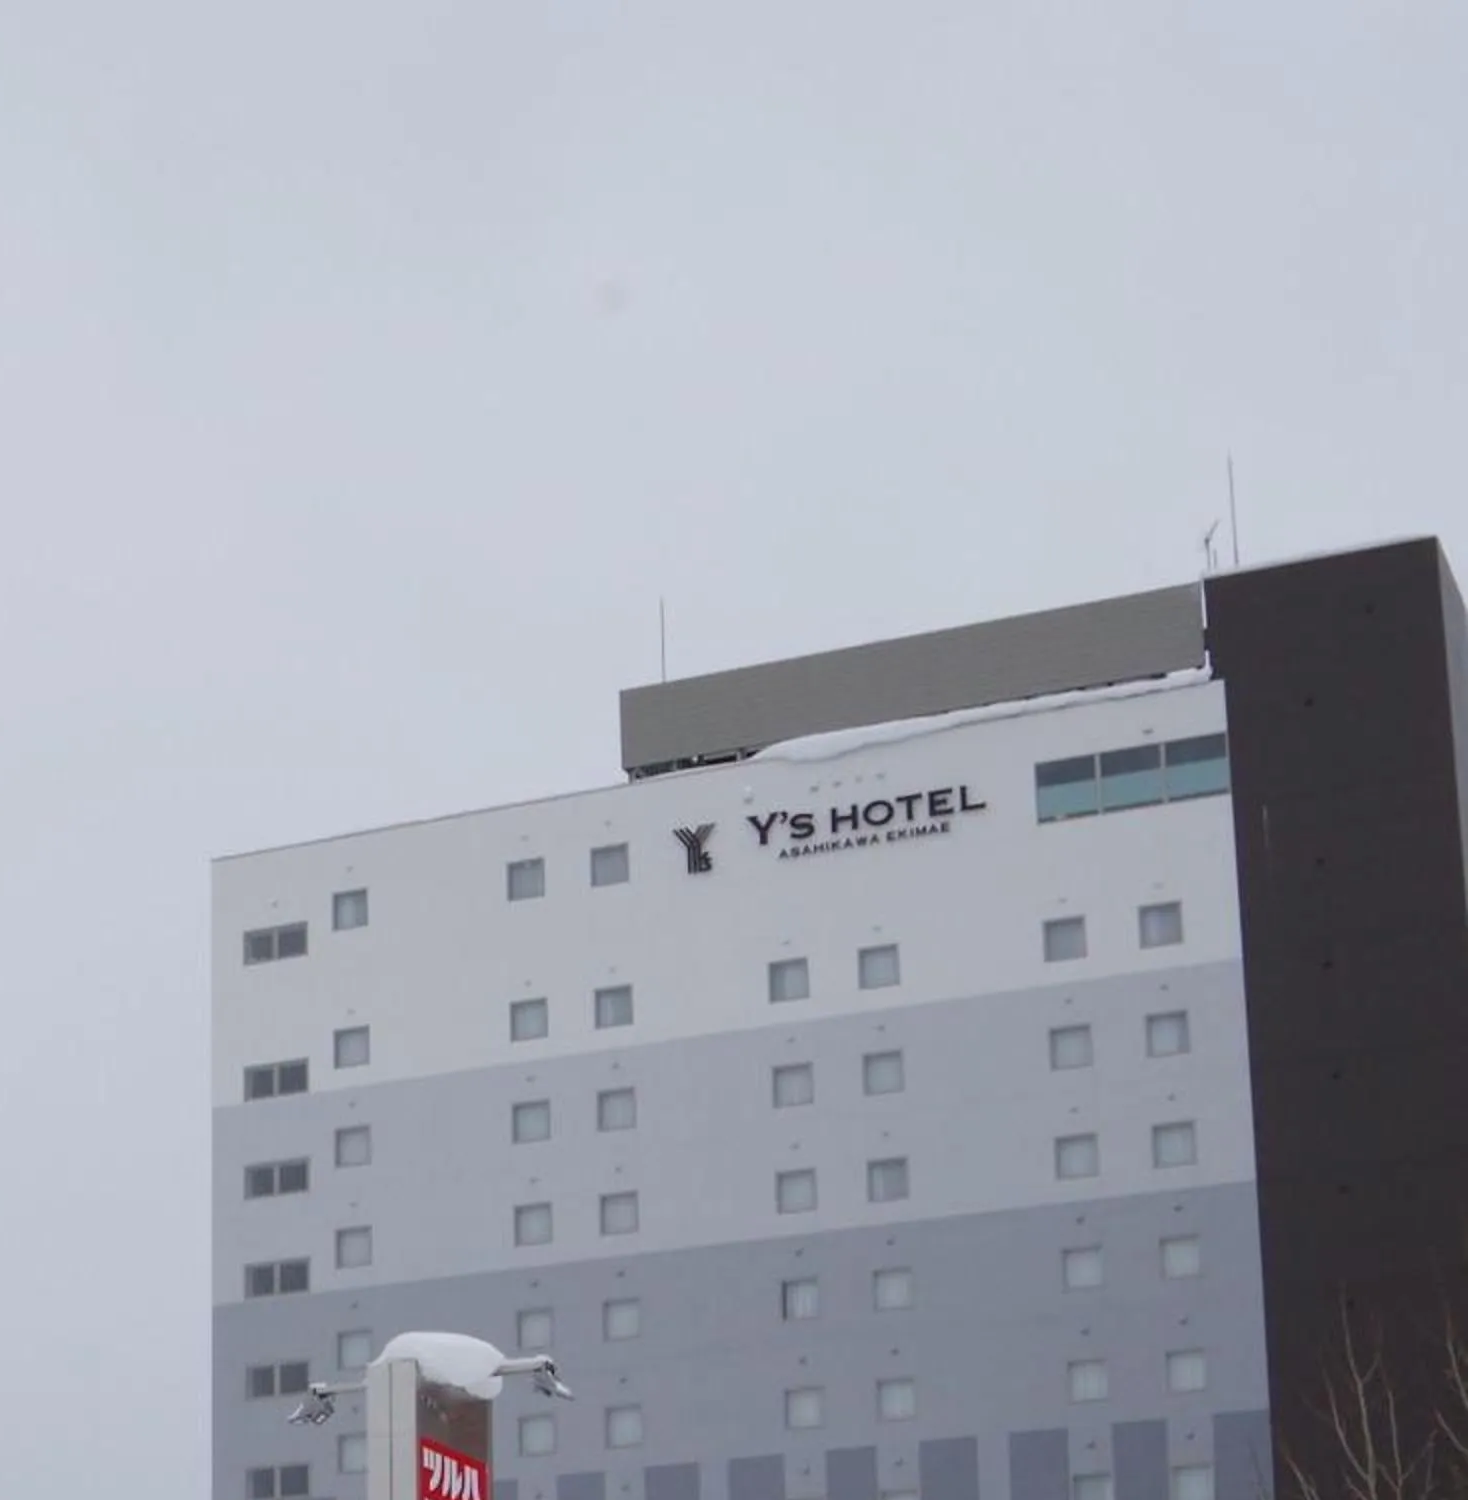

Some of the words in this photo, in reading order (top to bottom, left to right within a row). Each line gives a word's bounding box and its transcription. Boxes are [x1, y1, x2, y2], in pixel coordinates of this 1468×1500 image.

[830, 785, 988, 834] HOTEL
[778, 834, 881, 860] ASAHIKAWA
[885, 821, 951, 843] EKIMAE
